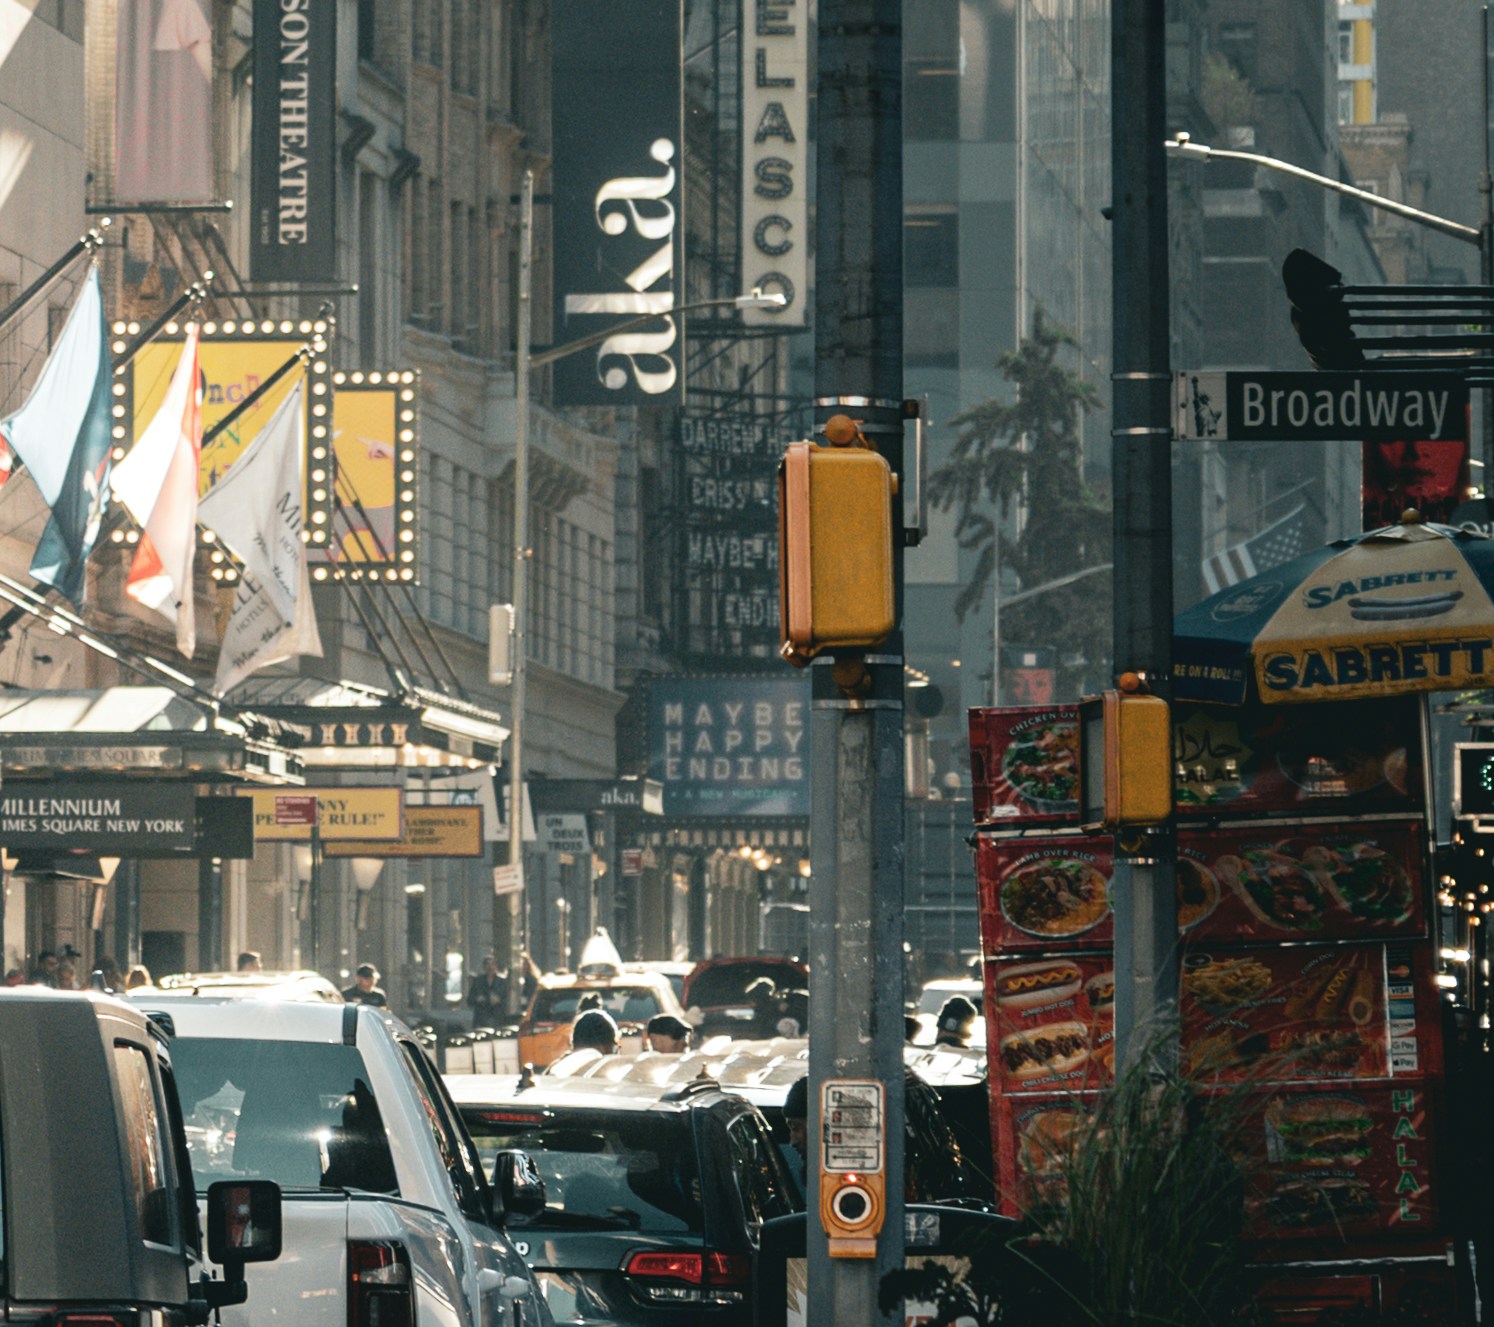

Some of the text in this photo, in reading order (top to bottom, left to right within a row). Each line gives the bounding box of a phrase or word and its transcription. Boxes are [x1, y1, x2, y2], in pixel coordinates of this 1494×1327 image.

[279, 72, 310, 245] THEATRE
[1242, 380, 1449, 440] Broadway
[1302, 570, 1458, 609] SABRETT
[1265, 639, 1493, 691] SABRETT
[665, 703, 804, 727] MAYBE
[1009, 711, 1057, 736] CHICKEN
[665, 730, 804, 753] HAPPY
[665, 757, 805, 780] ENDING
[317, 799, 348, 811] NNY
[601, 786, 641, 806] aka.
[2, 819, 184, 835] IMES SQUARE NEW YORK
[546, 817, 564, 828] UN
[553, 829, 585, 839] DEUX
[548, 841, 584, 852] TROIS
[1043, 849, 1069, 858] OVER
[1072, 850, 1096, 863] RICE
[1391, 986, 1410, 995] VISA
[1391, 1089, 1421, 1221] HALAL
